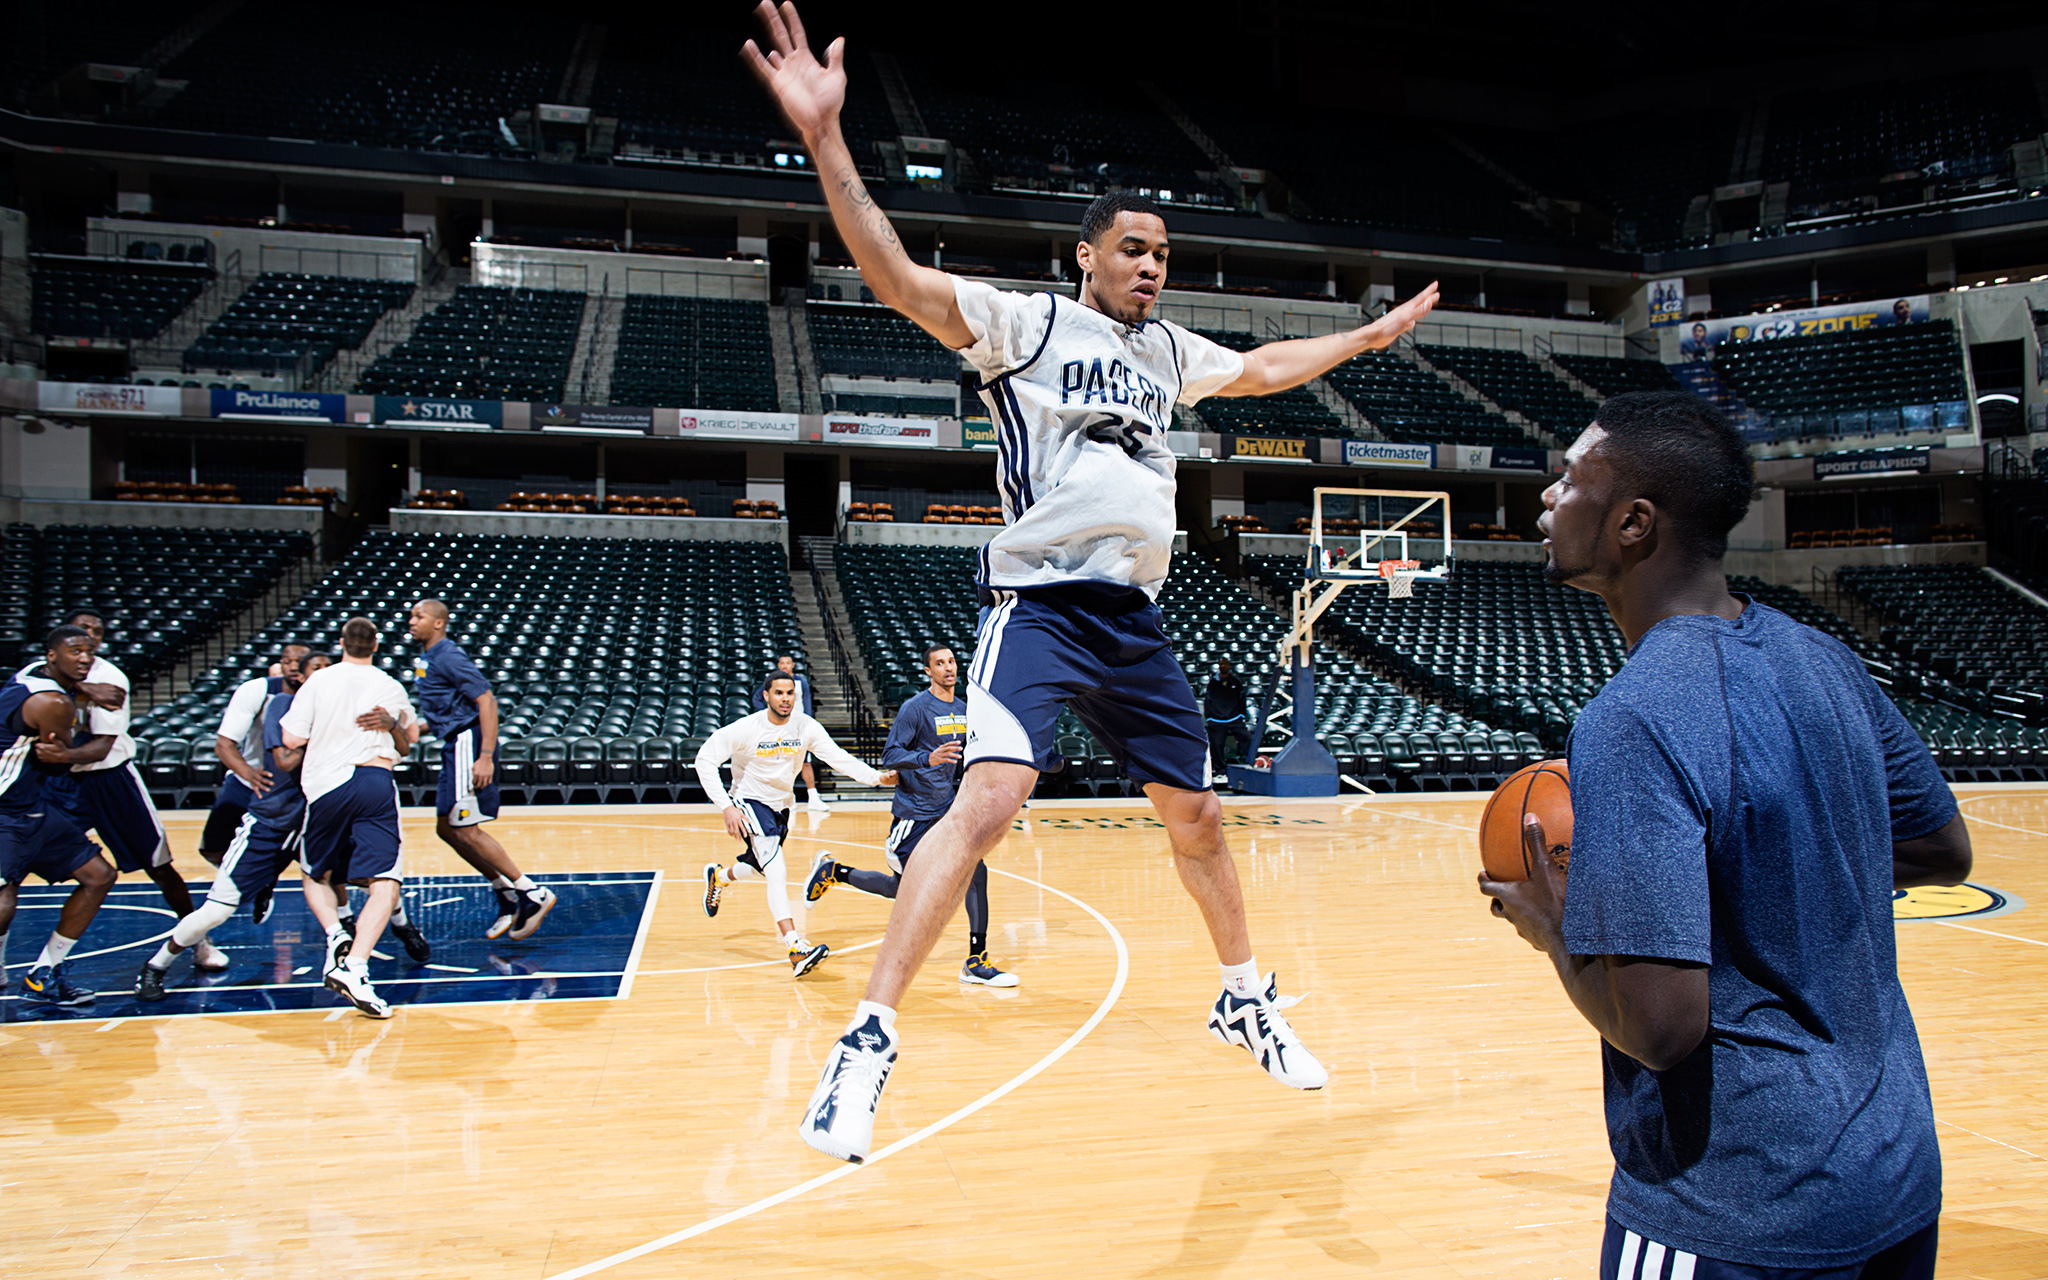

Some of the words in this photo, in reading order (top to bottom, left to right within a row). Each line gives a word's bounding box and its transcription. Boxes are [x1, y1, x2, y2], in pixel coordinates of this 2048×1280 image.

[1060, 355, 1167, 434] PACERS
[420, 402, 476, 420] STAR
[699, 419, 736, 429] KRIEG
[741, 420, 797, 431] DEVAULT
[1348, 443, 1431, 460] ticketmaster
[1816, 461, 1859, 474] SPORT
[1859, 456, 1928, 471] GRAPHICS
